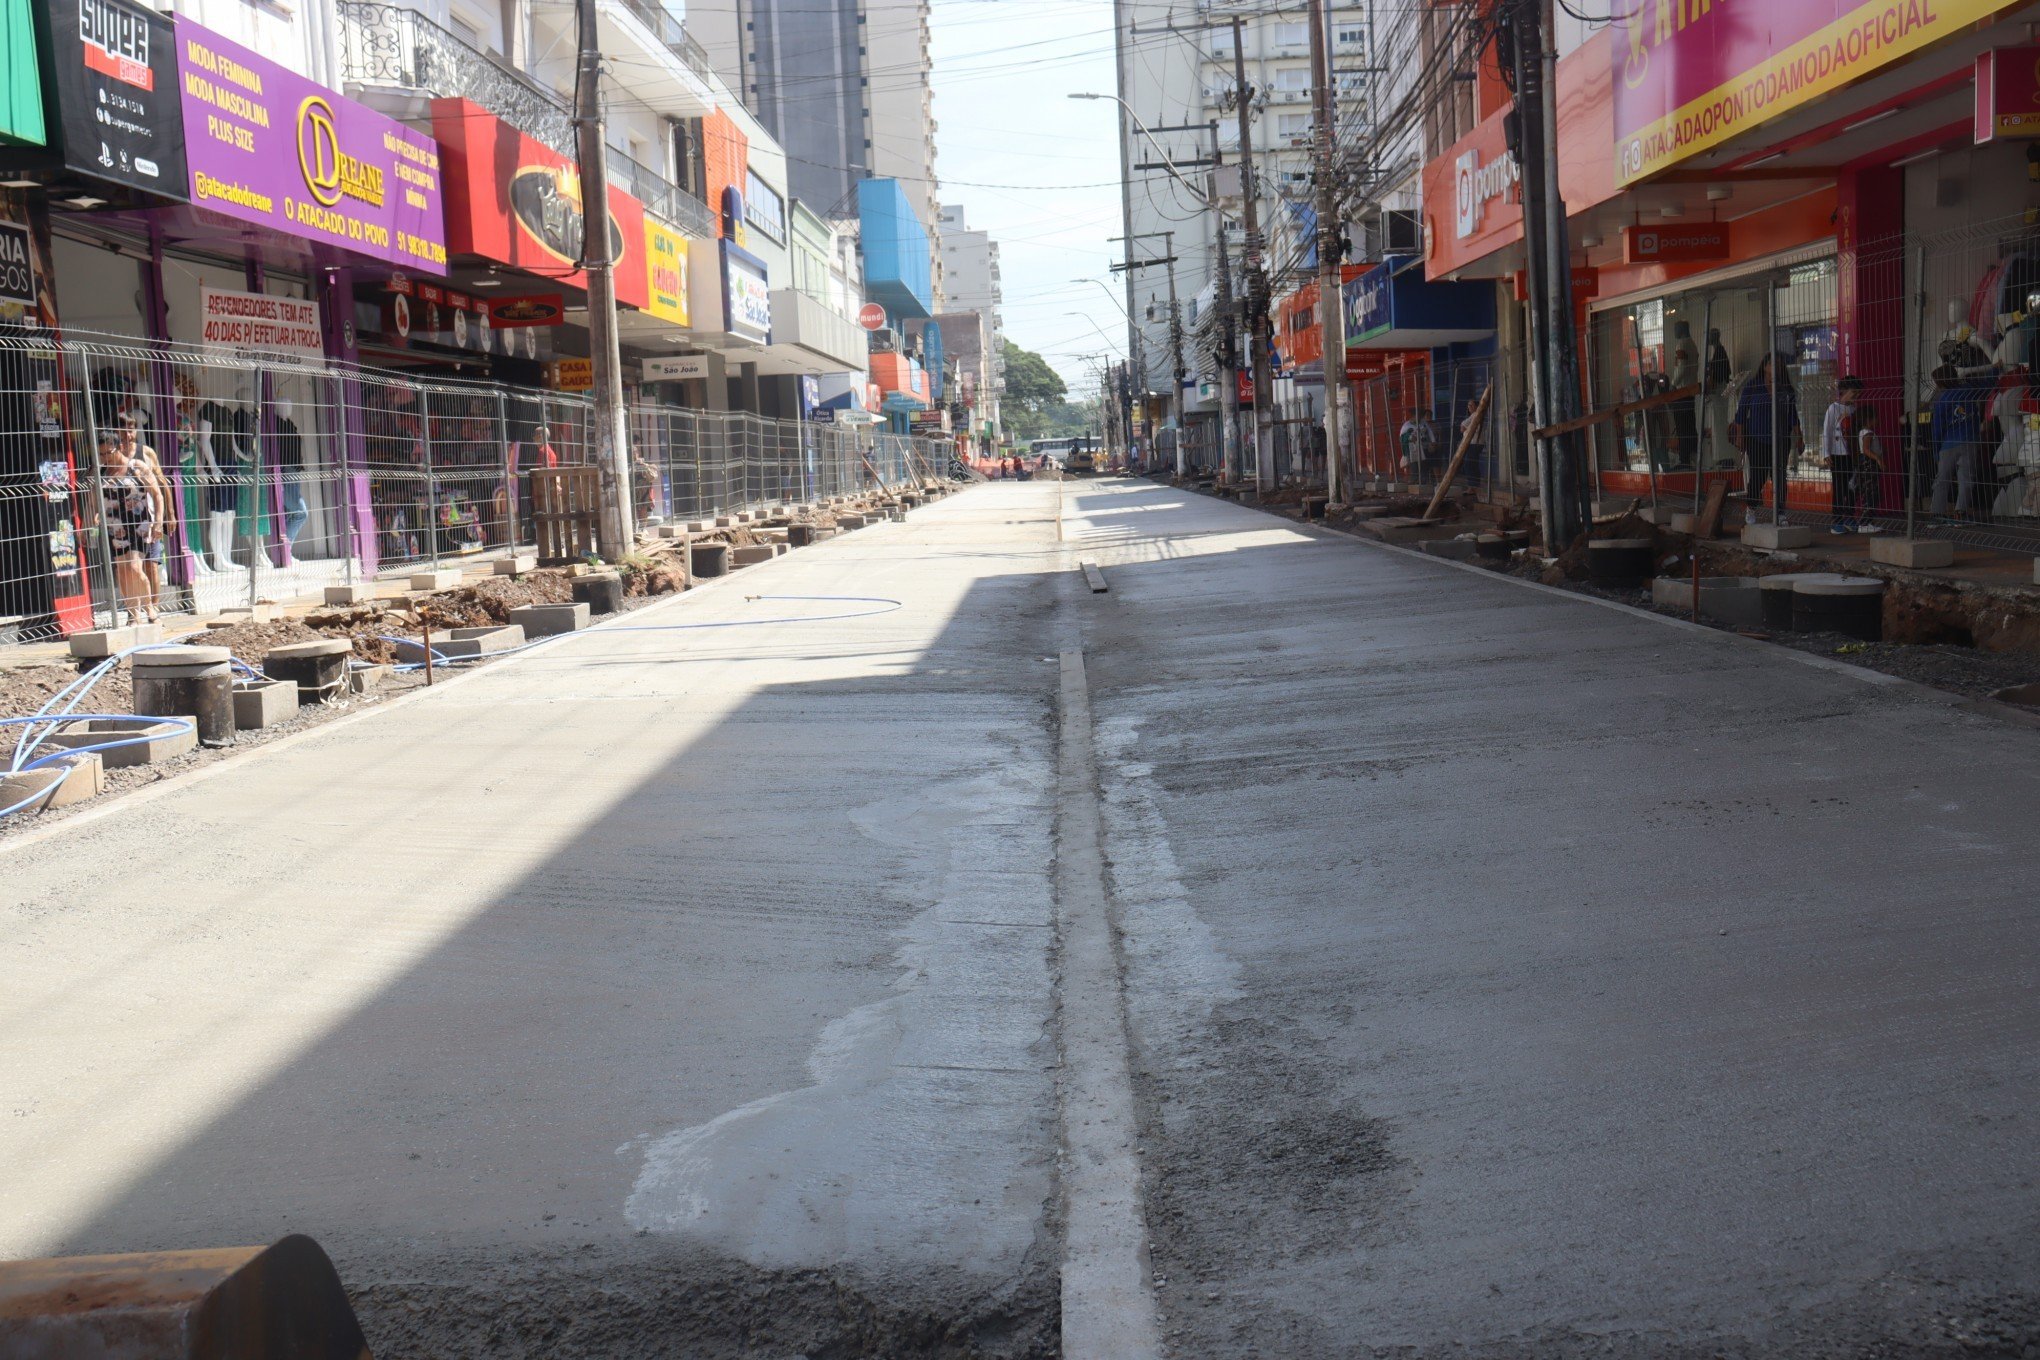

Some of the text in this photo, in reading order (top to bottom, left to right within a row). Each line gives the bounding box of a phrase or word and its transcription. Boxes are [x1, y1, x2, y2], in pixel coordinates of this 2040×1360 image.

[187, 40, 263, 95] MODA FEMININA
[185, 72, 269, 128] MODA MASCULINA
[208, 115, 255, 152] PLUS SIZE
[285, 197, 389, 247] O ATACADO DO POVO
[208, 295, 313, 325] REVENDEDORES TEM ATÉ
[860, 312, 884, 322] mundi
[205, 321, 321, 349] 40 DIAS P/ EFETUAR A TROCA
